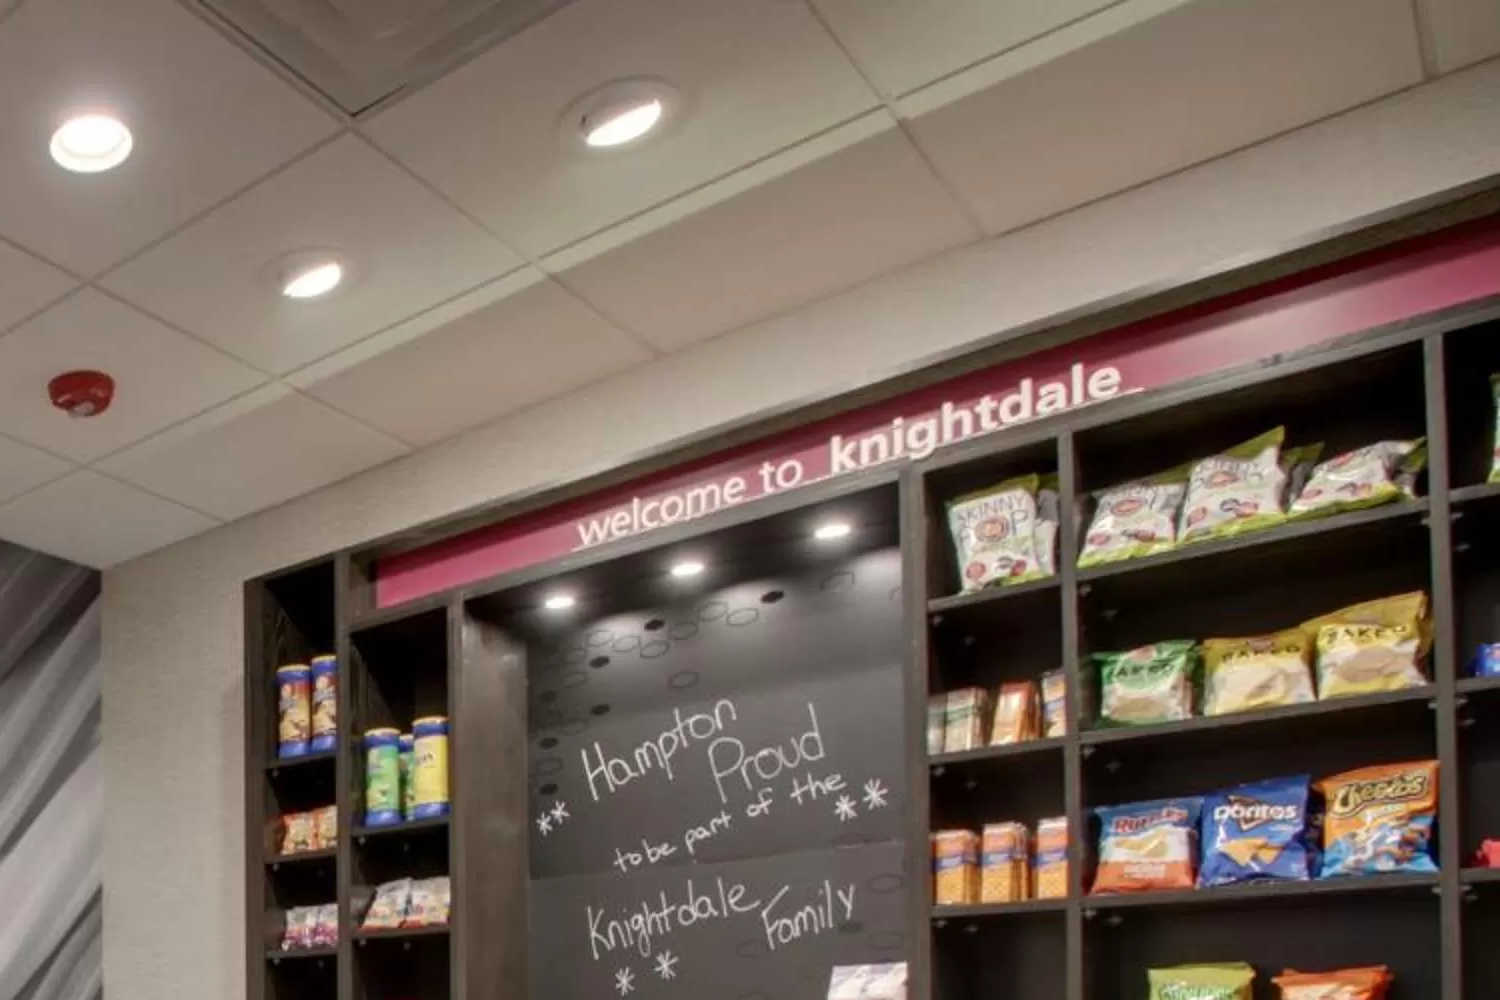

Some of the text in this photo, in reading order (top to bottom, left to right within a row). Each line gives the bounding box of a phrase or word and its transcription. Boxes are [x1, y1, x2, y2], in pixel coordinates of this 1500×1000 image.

[577, 363, 1121, 547] welcome to knightdale
[581, 699, 825, 804] Hampton Proud
[685, 810, 732, 855] part
[746, 787, 773, 817] of
[790, 772, 847, 805] the
[587, 876, 856, 961] Knightdale Family
